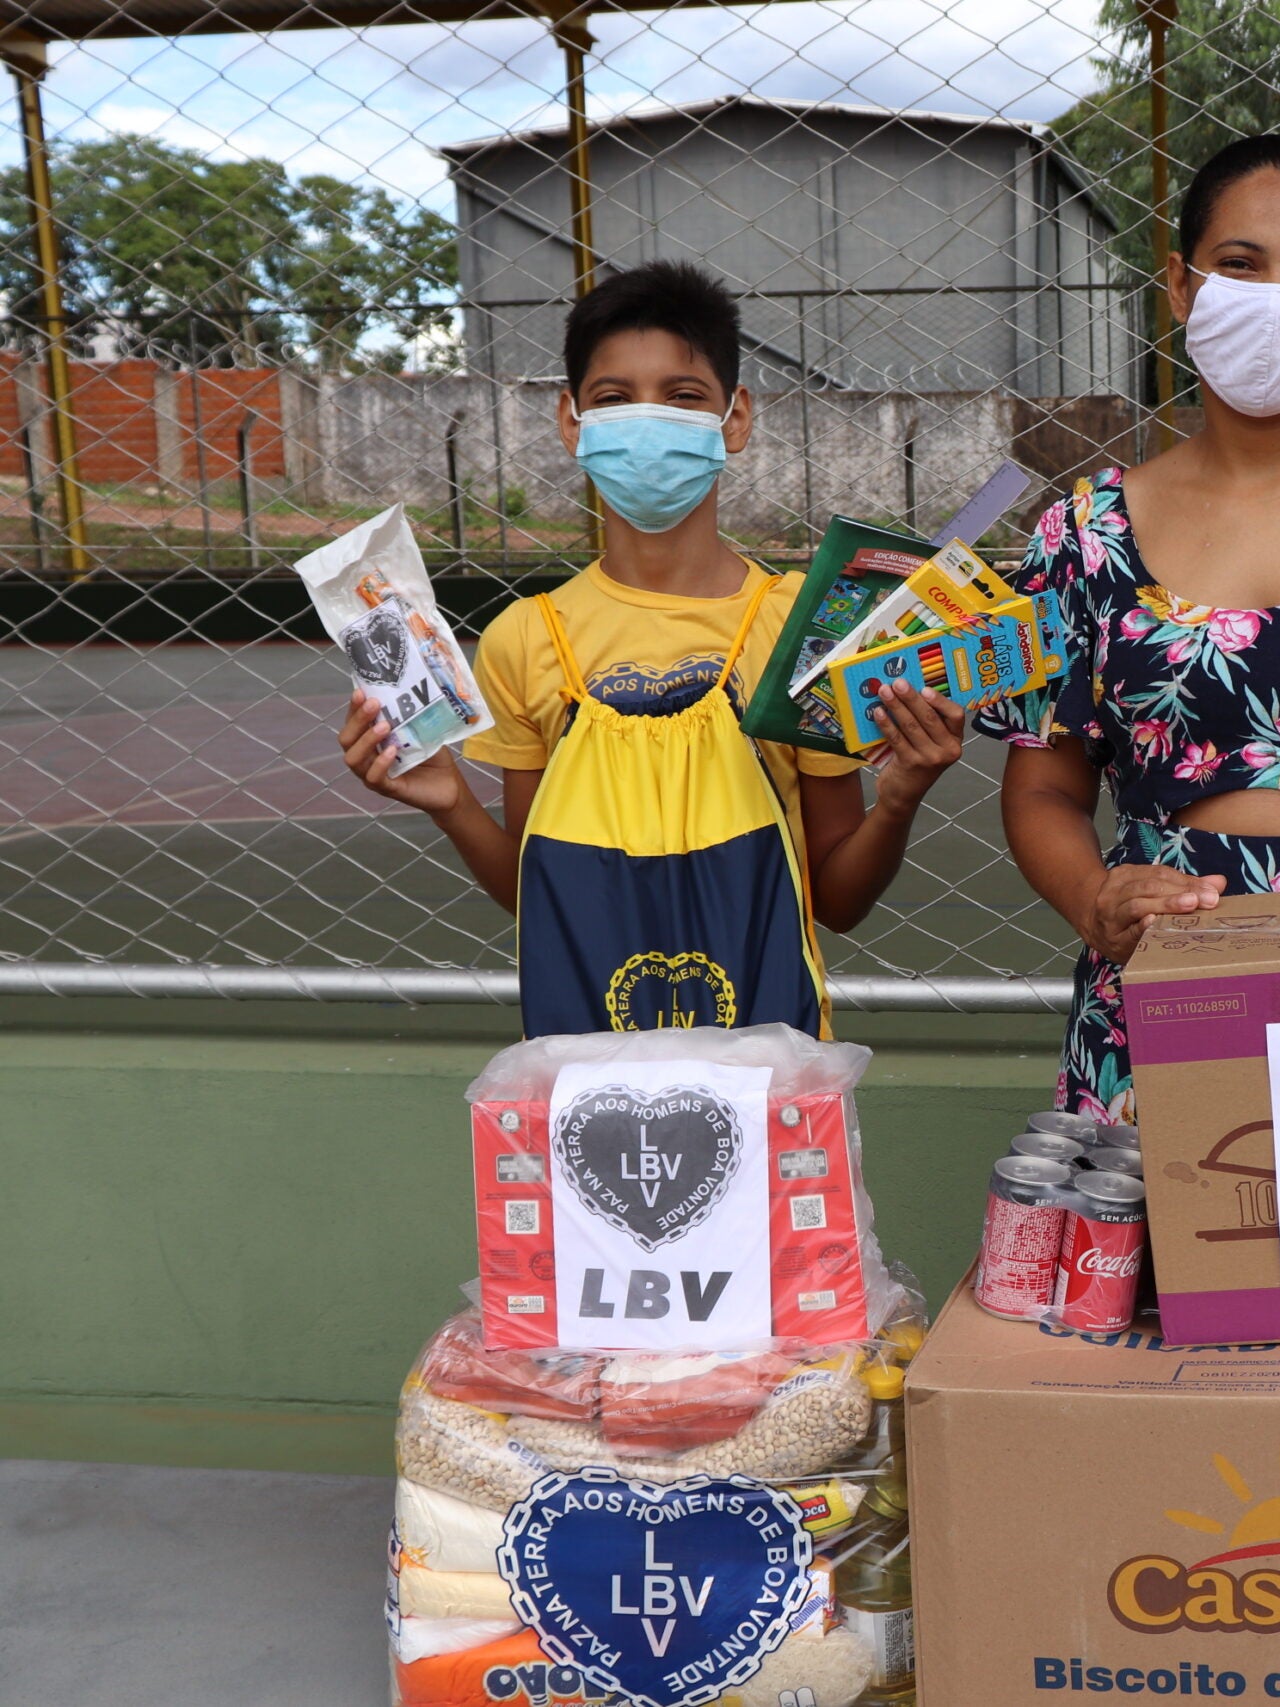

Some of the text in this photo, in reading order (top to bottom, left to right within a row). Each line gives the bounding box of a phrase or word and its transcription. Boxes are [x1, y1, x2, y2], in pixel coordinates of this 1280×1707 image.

[366, 641, 392, 664] LBV
[976, 649, 1000, 687] COR
[992, 635, 1014, 678] LÁPIS
[1018, 622, 1035, 675] Jandainha
[381, 678, 430, 729] LBV
[602, 670, 722, 698] AOS HOMENS
[618, 974, 640, 1020] TERRA
[641, 964, 667, 978] AOS
[704, 972, 720, 990] DE
[715, 994, 727, 1024] BOA
[1146, 1000, 1240, 1016] PAT: 110268590
[568, 1098, 730, 1231] PAZ NA TERRA AOS HOMENS DE BOA VONTADE
[620, 1152, 682, 1180] LBV
[1100, 1214, 1120, 1222] SEM
[578, 1268, 732, 1322] LBV
[525, 1489, 788, 1693] PAZ NA TERRA AOS HOMENS DE BOA VONTADE
[611, 1574, 714, 1616] LBV
[1034, 1658, 1246, 1698] Biscoito
